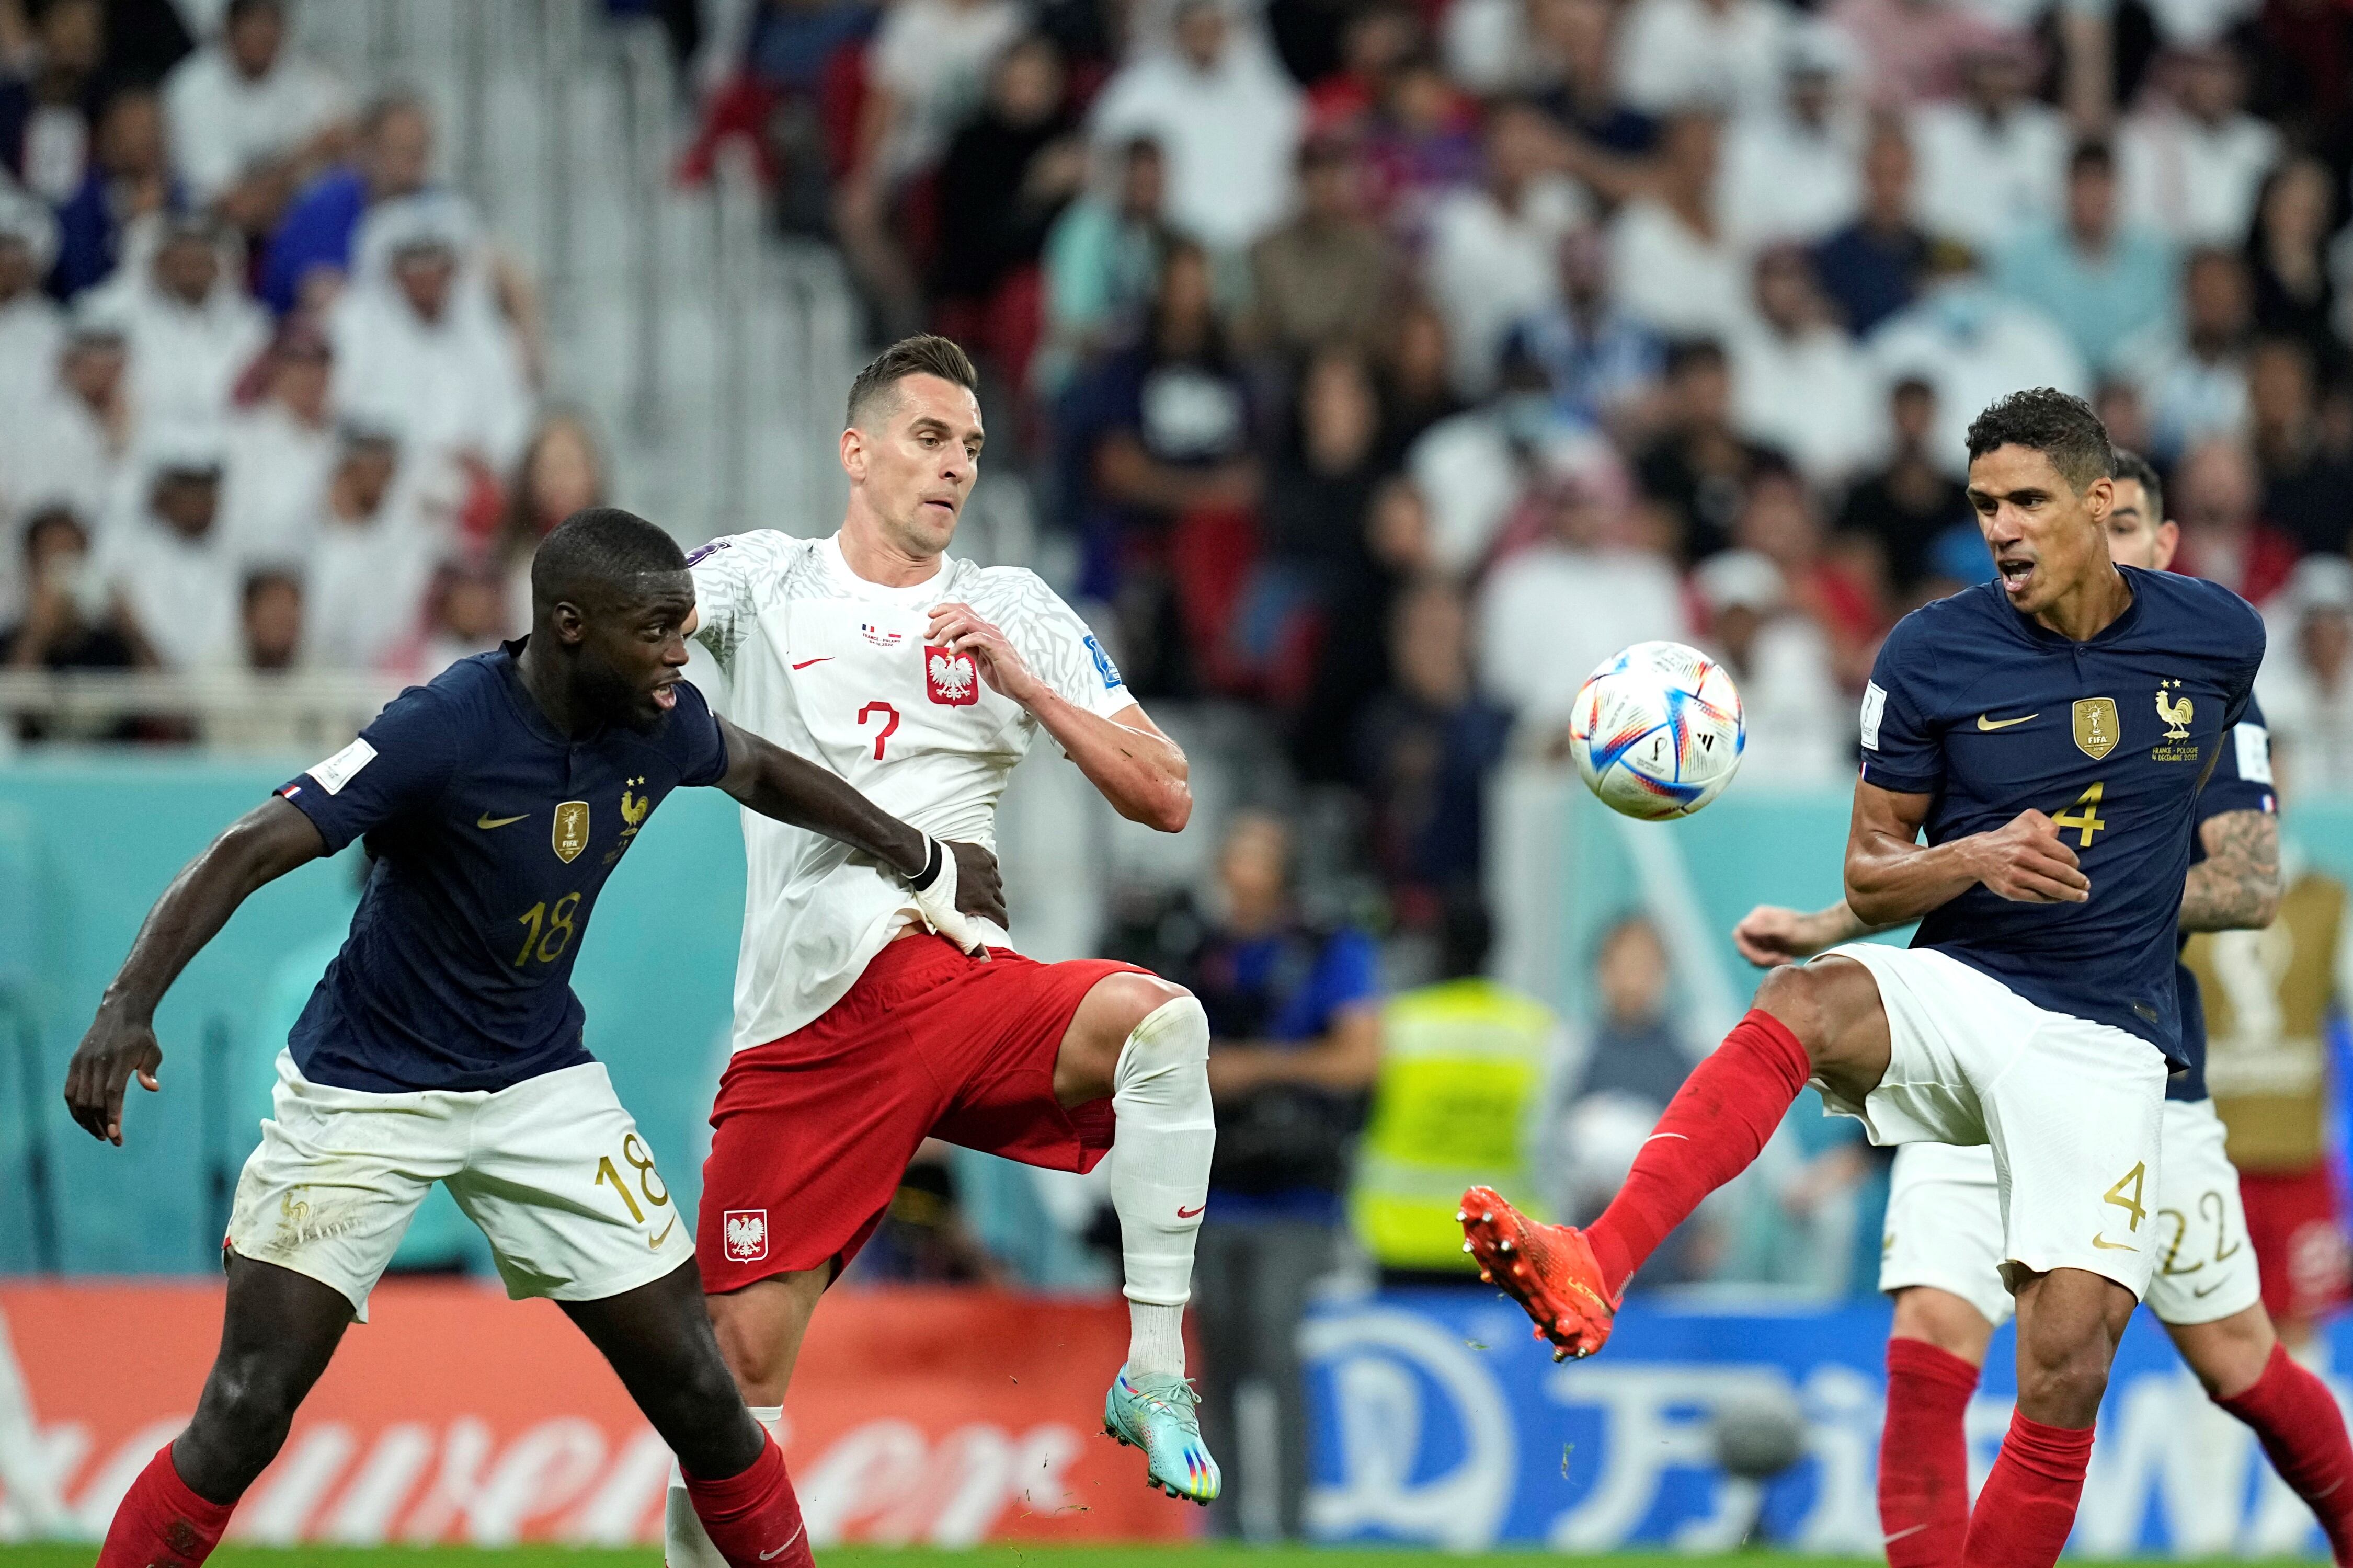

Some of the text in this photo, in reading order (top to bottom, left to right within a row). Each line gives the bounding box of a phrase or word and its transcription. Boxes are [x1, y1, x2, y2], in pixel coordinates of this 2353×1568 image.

[858, 701, 899, 760] 7
[2050, 781, 2105, 847] 4
[515, 892, 581, 966] 18
[595, 1134, 668, 1224] 18
[2103, 1160, 2146, 1233] 4
[2157, 1190, 2240, 1275] 22
